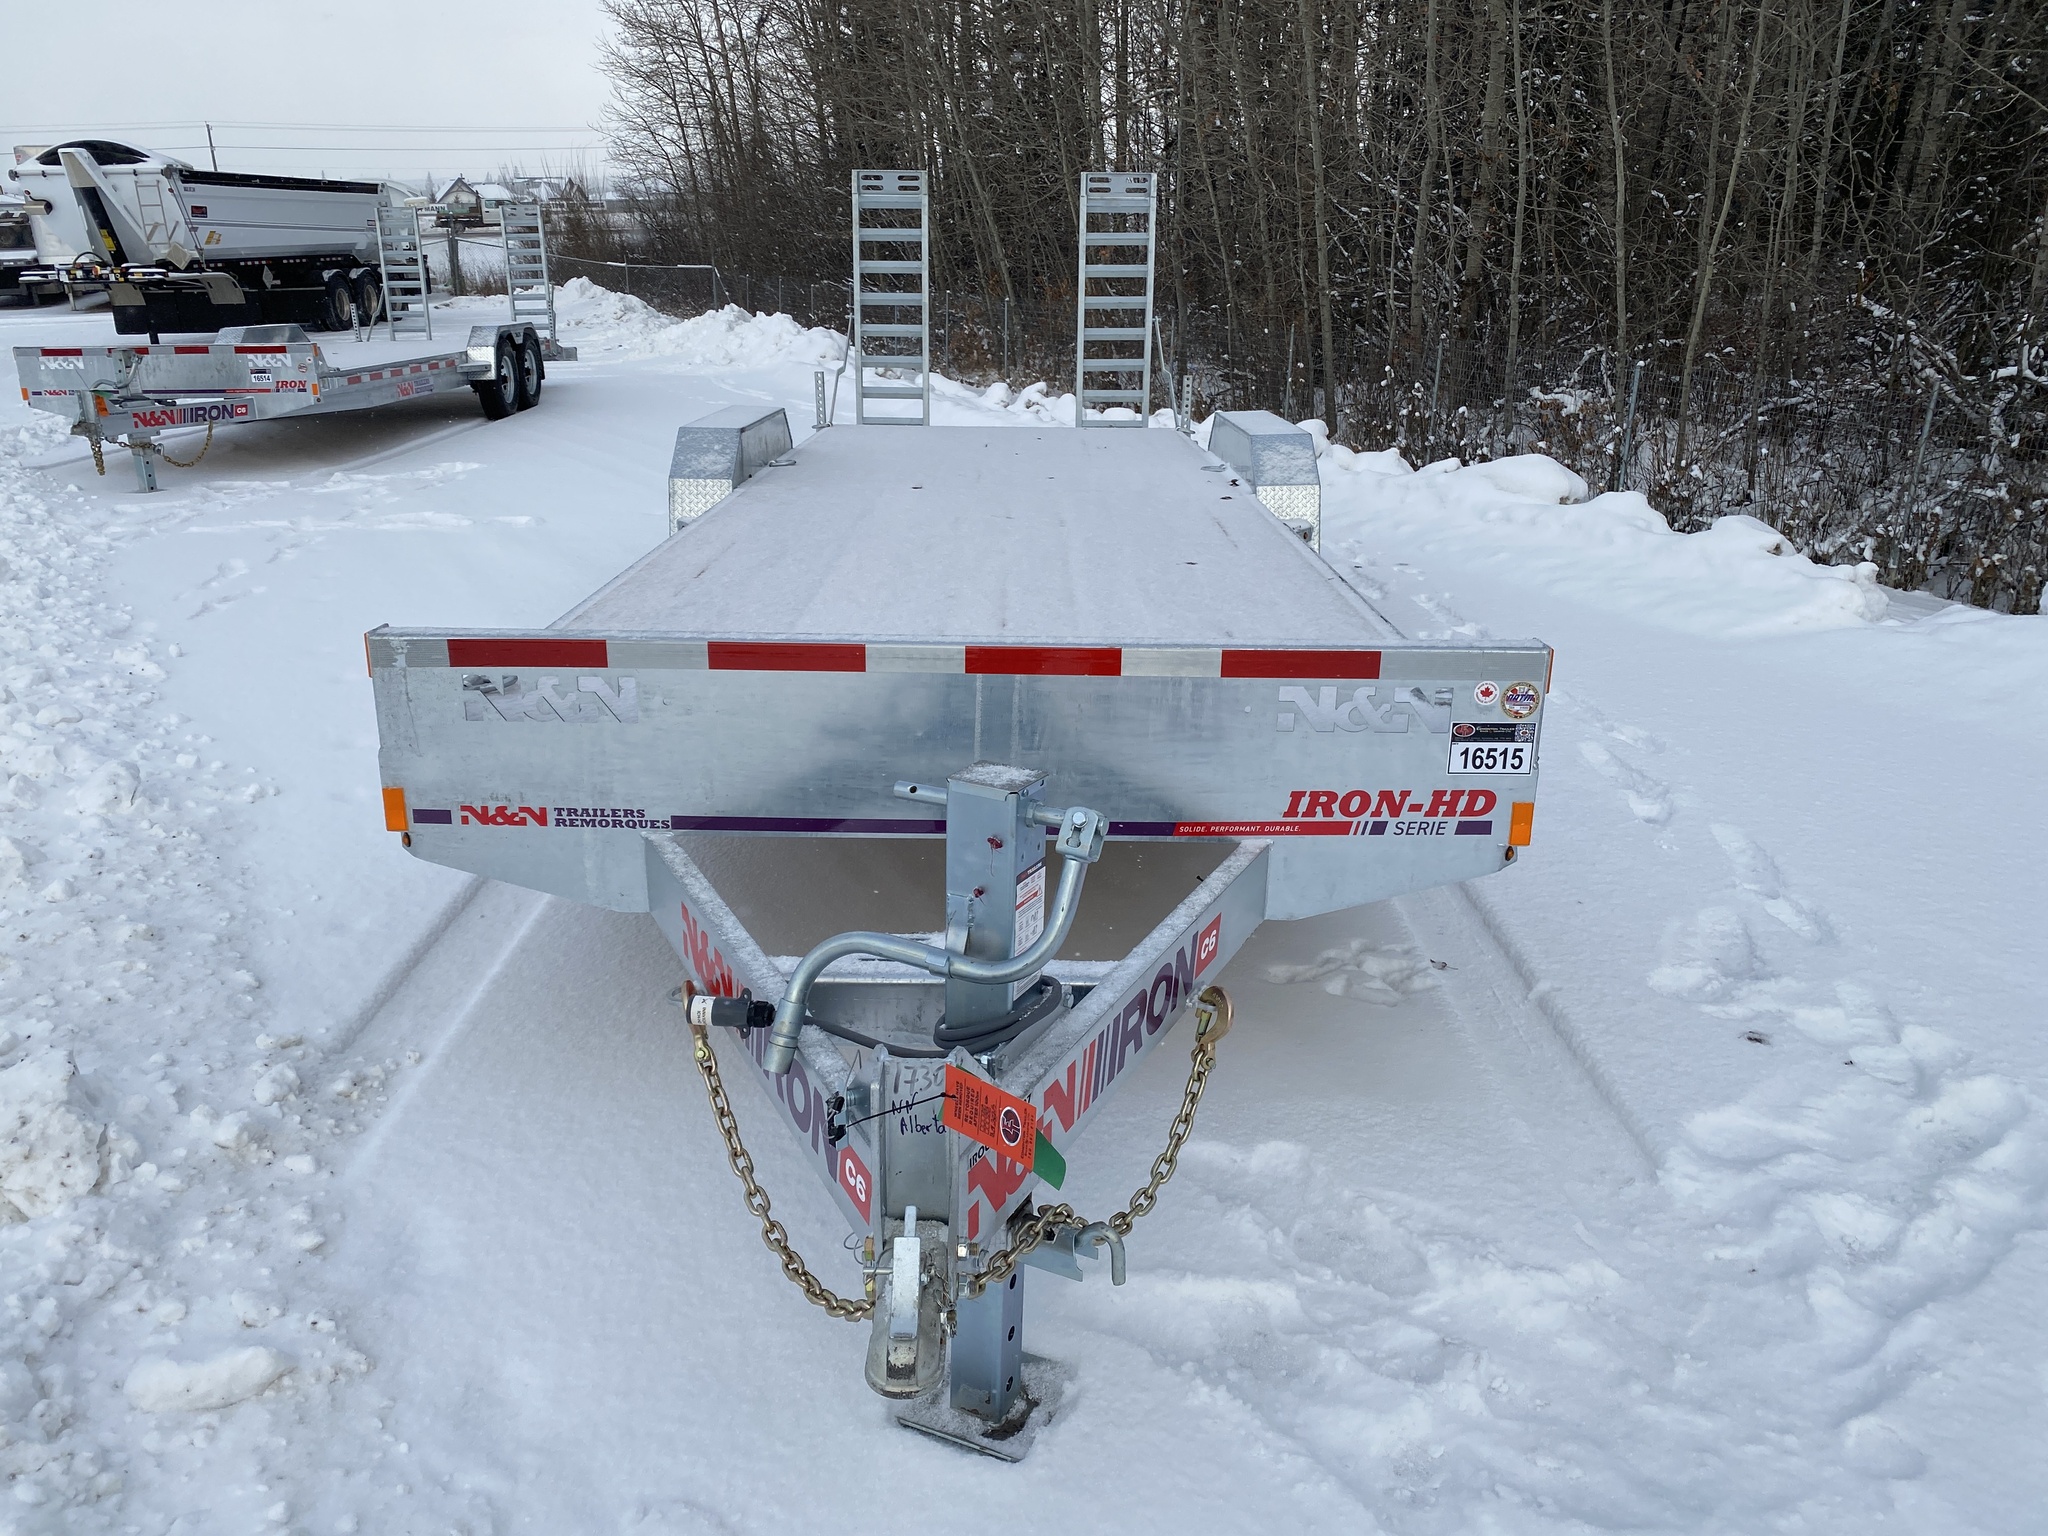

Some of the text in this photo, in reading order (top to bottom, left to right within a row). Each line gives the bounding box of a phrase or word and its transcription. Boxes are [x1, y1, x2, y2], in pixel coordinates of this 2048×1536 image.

[247, 354, 292, 367] N&N
[275, 380, 307, 388] IRON
[132, 409, 176, 428] N&N
[190, 404, 234, 422] IRON
[462, 674, 639, 724] N&N
[1276, 686, 1454, 734] N&N
[1460, 747, 1524, 770] 16515
[1282, 789, 1496, 818] IRON-HD
[460, 805, 646, 826] N&N TRAILERS
[554, 818, 670, 830] REMORQUES
[1393, 821, 1448, 836] SERIE
[1107, 931, 1199, 1087] IRON
[1200, 929, 1217, 960] C6
[900, 1113, 947, 1136] Alberta
[845, 1158, 866, 1203] C6
